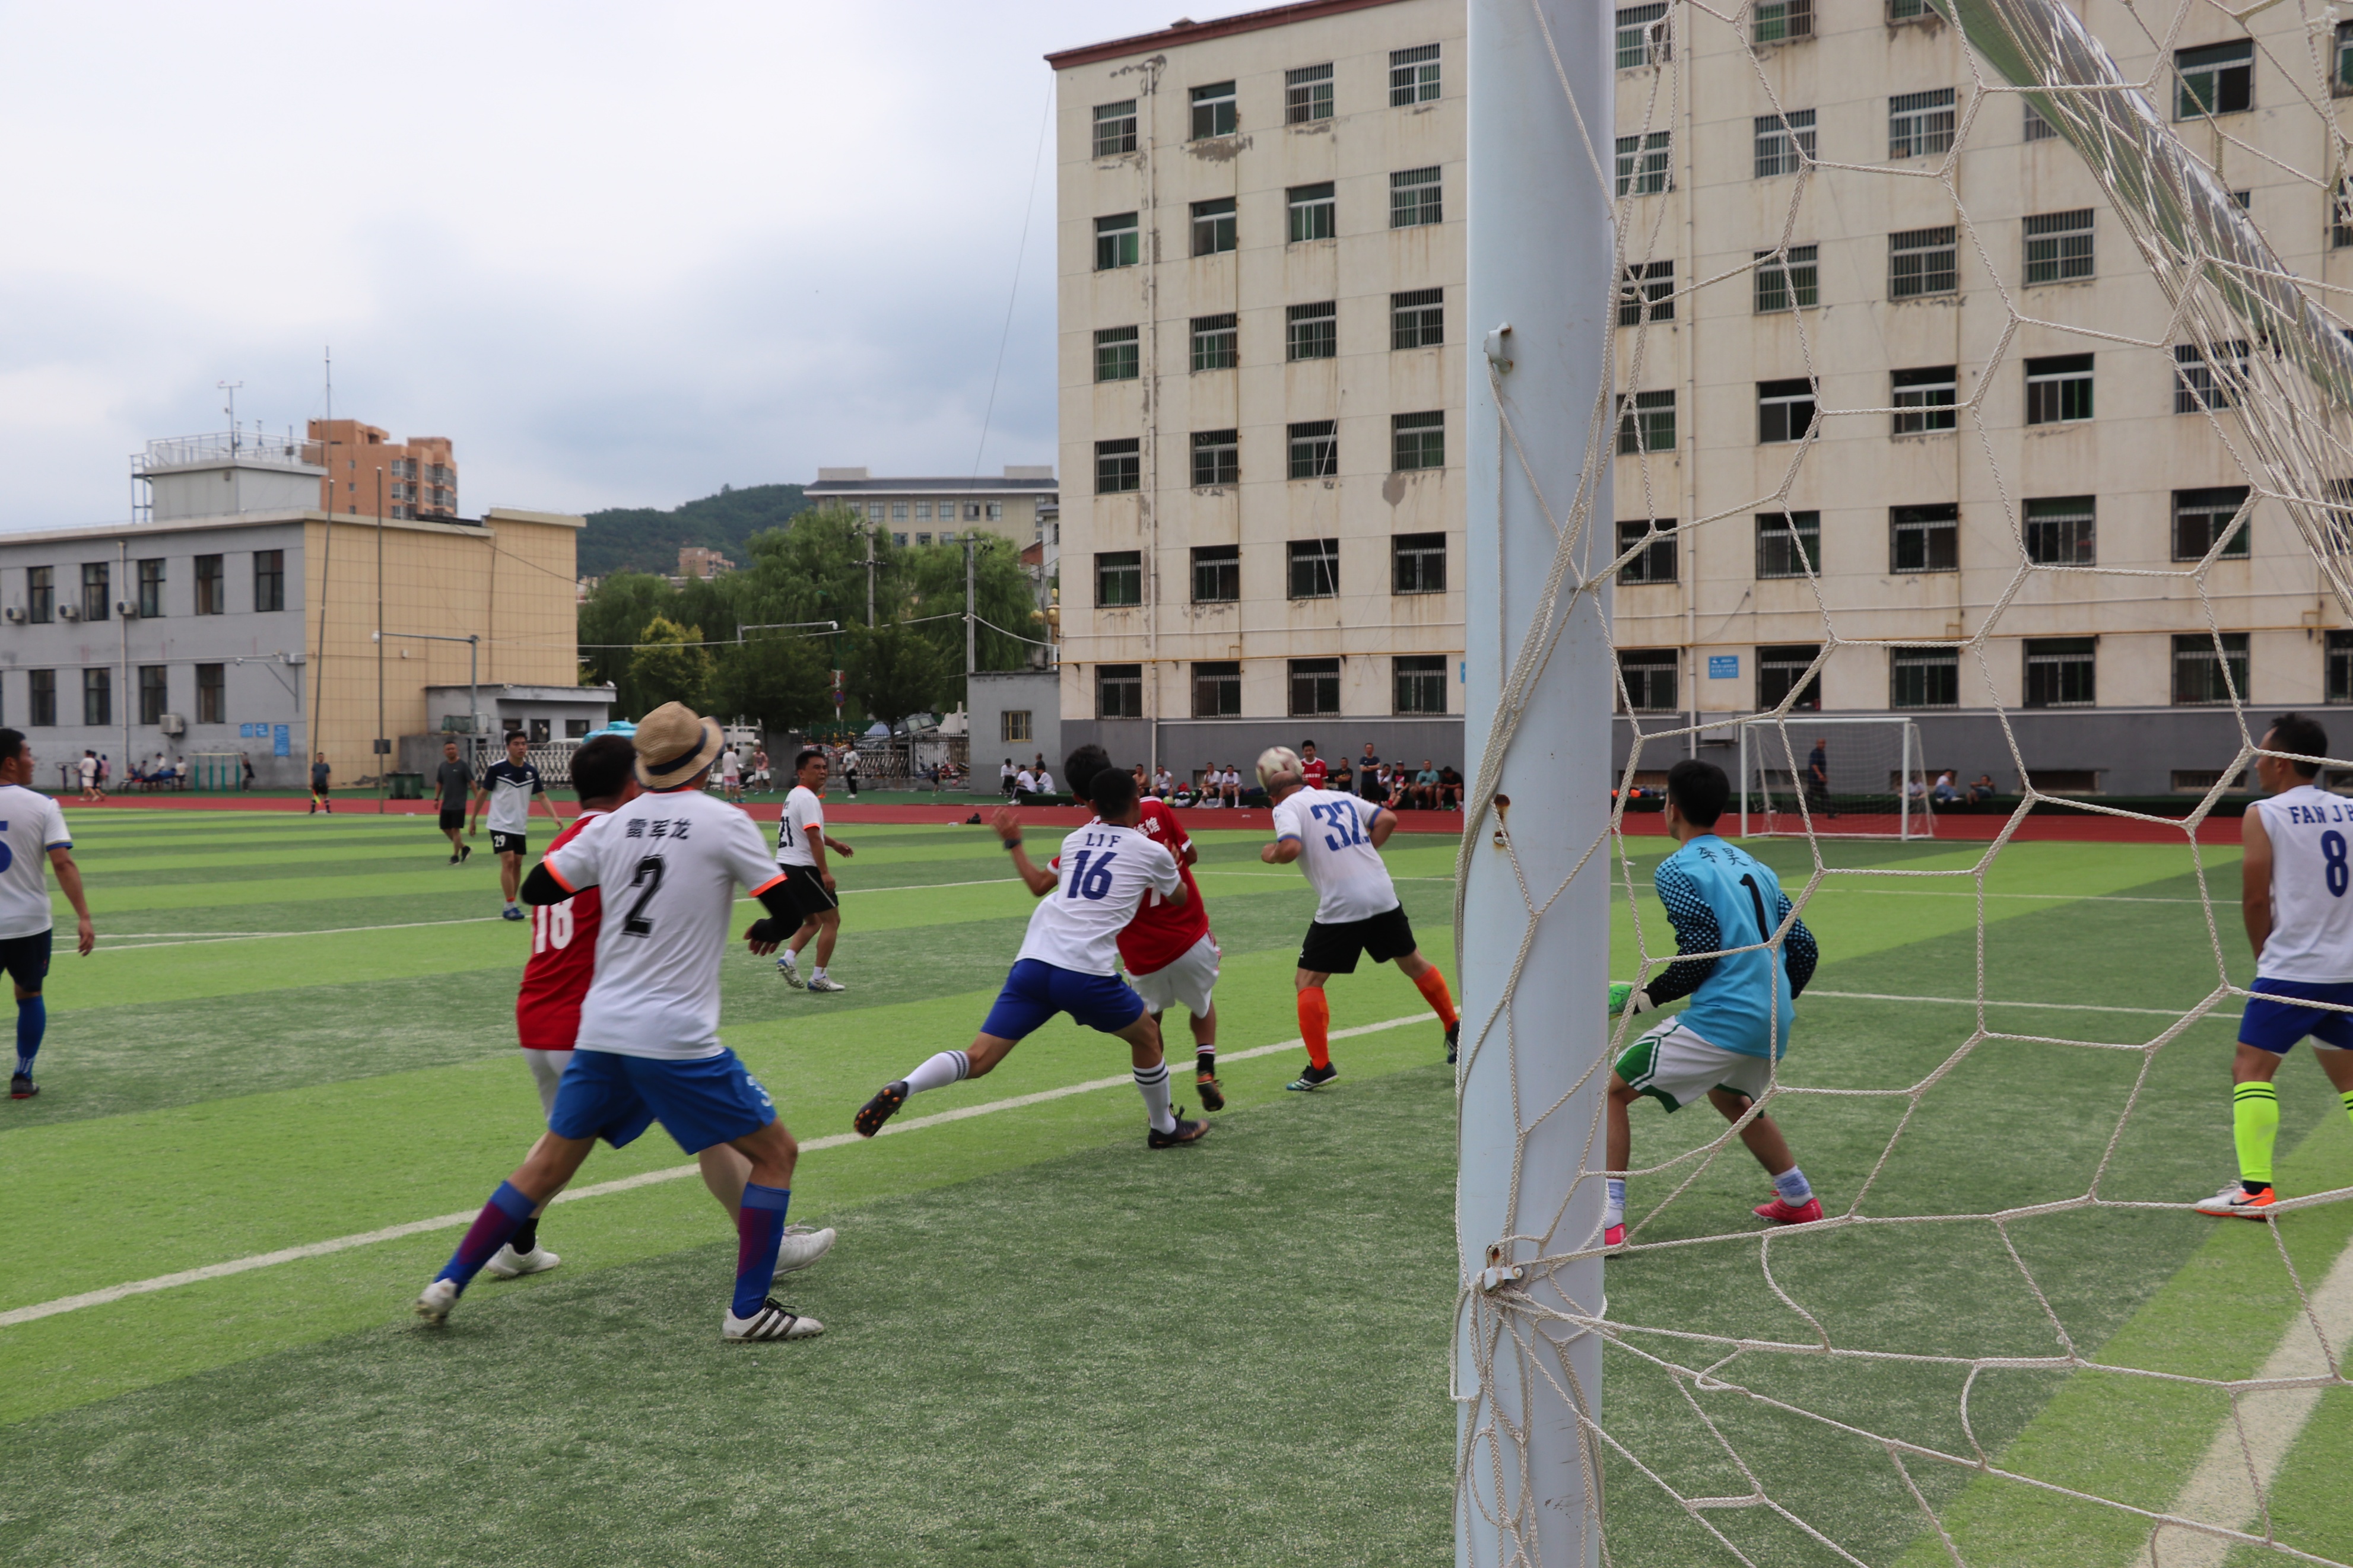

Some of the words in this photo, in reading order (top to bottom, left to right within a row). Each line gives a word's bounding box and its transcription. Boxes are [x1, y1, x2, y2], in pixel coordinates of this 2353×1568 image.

[625, 818, 692, 840] 雷军龙
[778, 816, 793, 848] 21
[1310, 800, 1370, 851] 32
[2288, 806, 2327, 823] FAN
[494, 835, 506, 847] 29
[2321, 830, 2348, 897] 8
[621, 854, 667, 938] 2
[1068, 850, 1117, 899] 16
[535, 896, 574, 954] 18
[1739, 873, 1770, 943] 1
